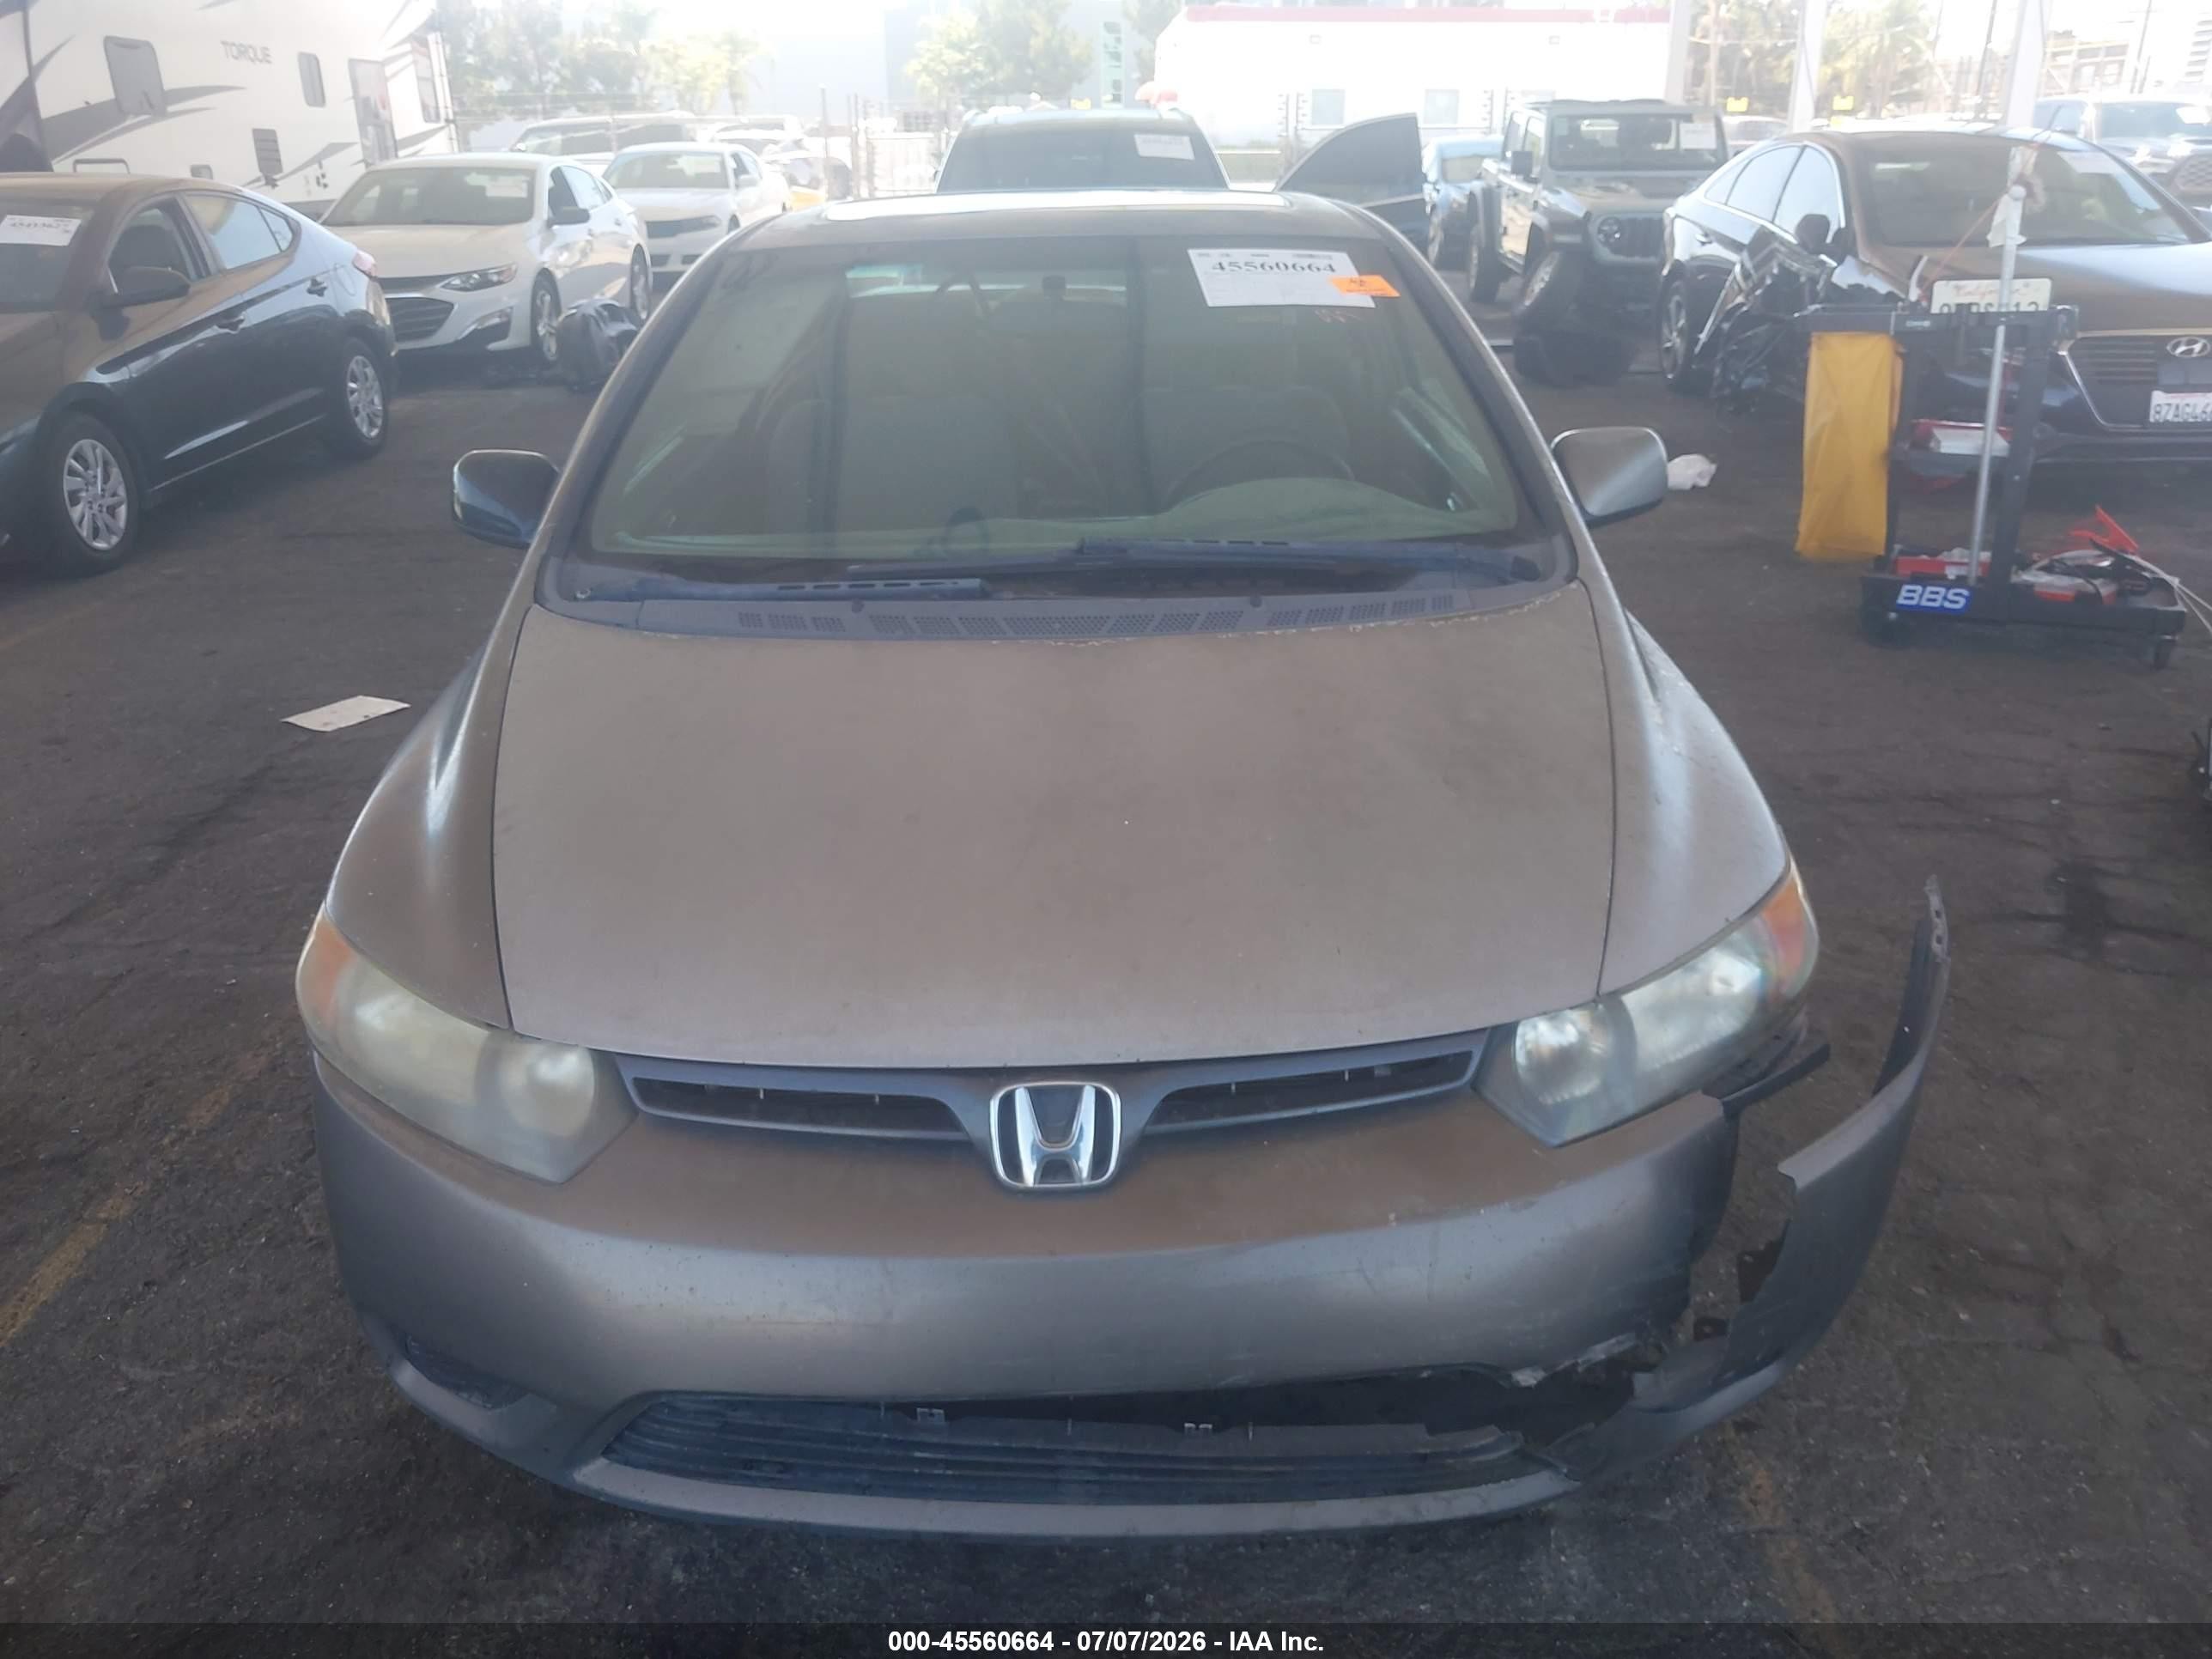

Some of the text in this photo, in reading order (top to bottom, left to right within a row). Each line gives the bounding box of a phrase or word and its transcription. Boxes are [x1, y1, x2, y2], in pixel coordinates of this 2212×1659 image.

[220, 40, 273, 65] TORQUE
[1212, 260, 1337, 274] 45560664
[1896, 584, 1971, 610] BBS
